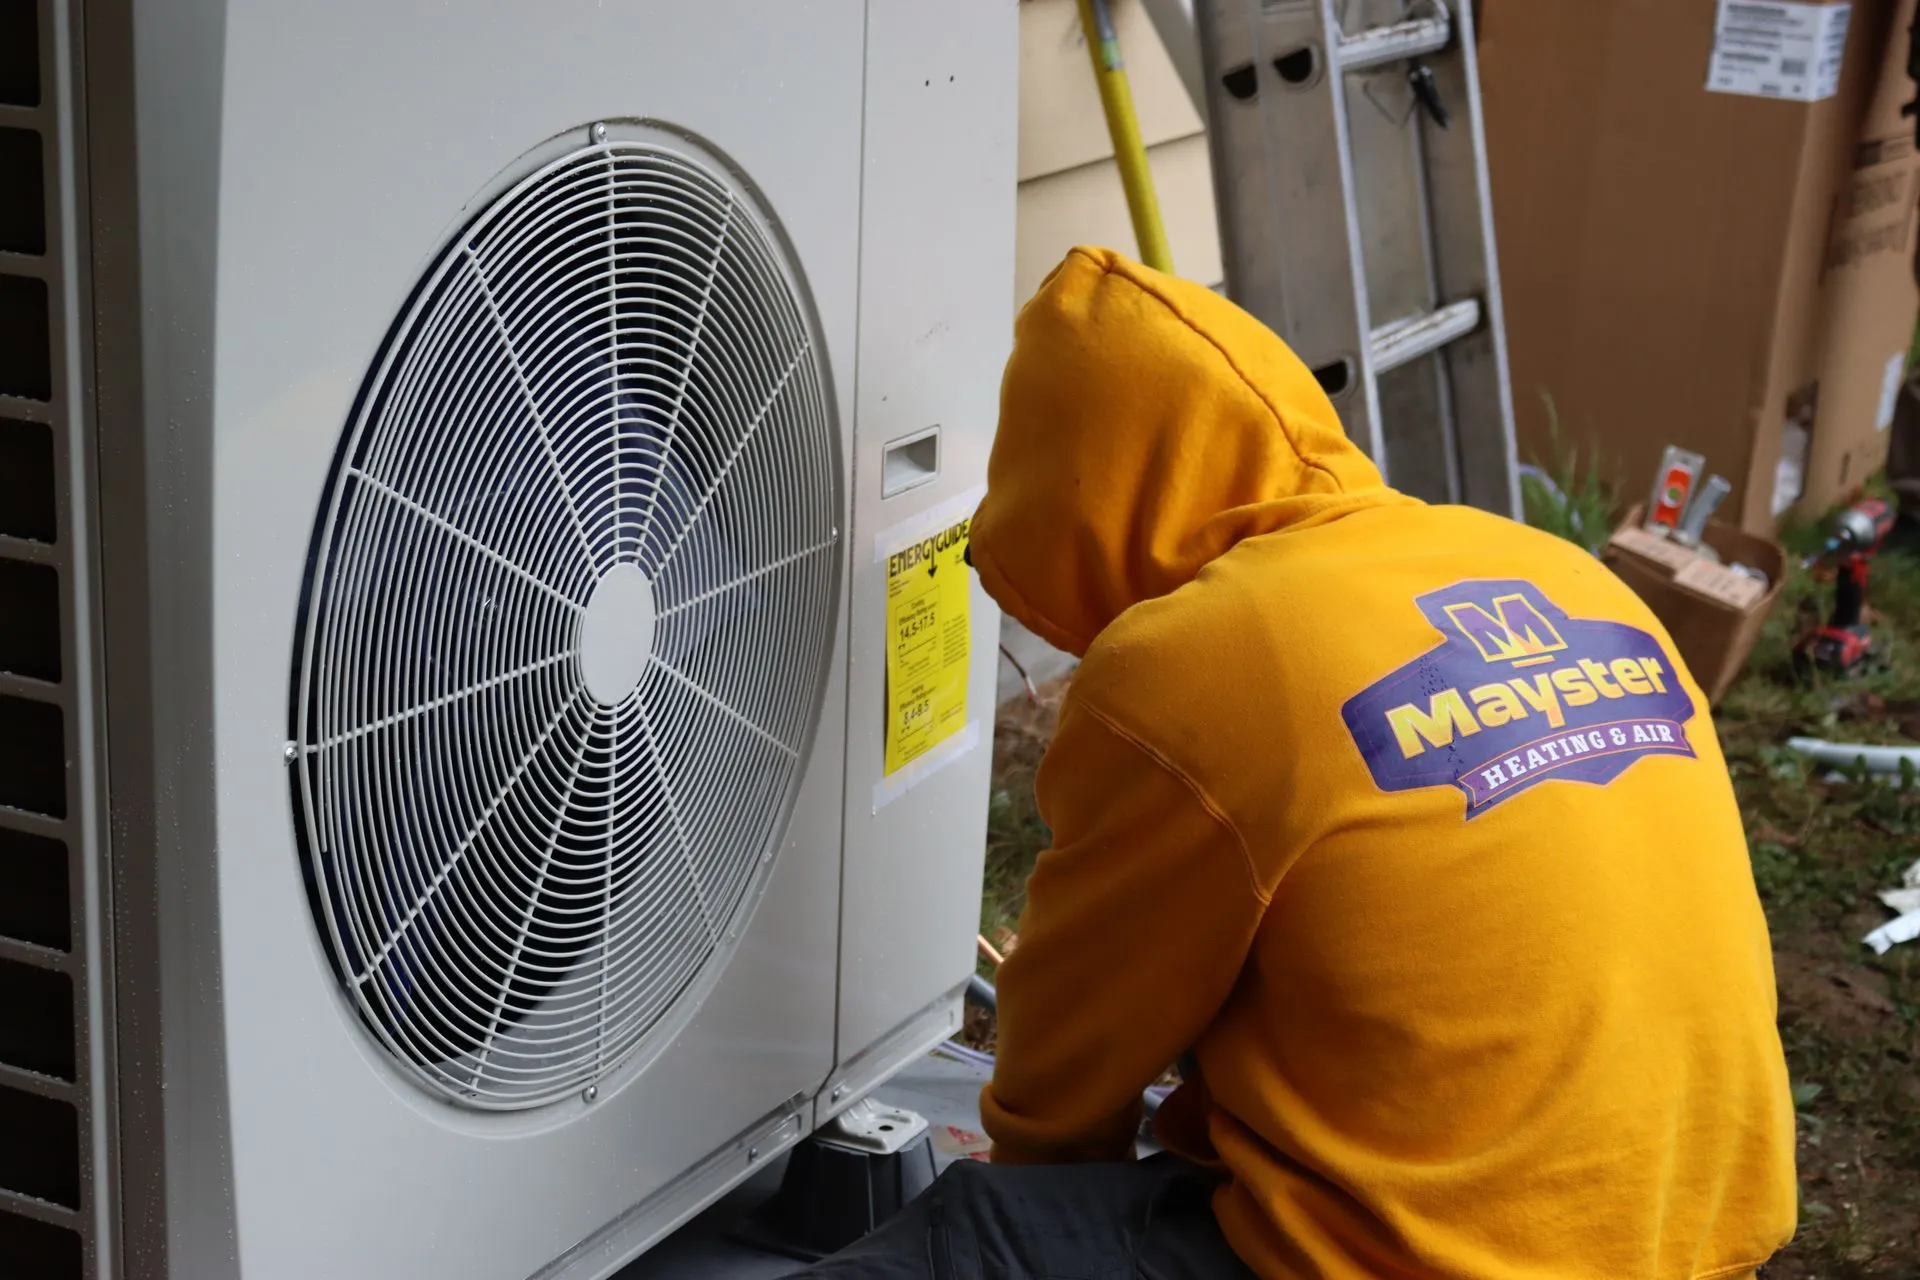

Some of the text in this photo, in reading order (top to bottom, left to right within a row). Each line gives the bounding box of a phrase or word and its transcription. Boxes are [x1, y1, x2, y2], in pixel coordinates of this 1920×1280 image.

[890, 518, 969, 578] ENERGYGUIDE
[900, 612, 935, 641] 14.5-17.5
[1385, 656, 1669, 760] Mayster
[1480, 723, 1674, 789] HEATING & AIR
